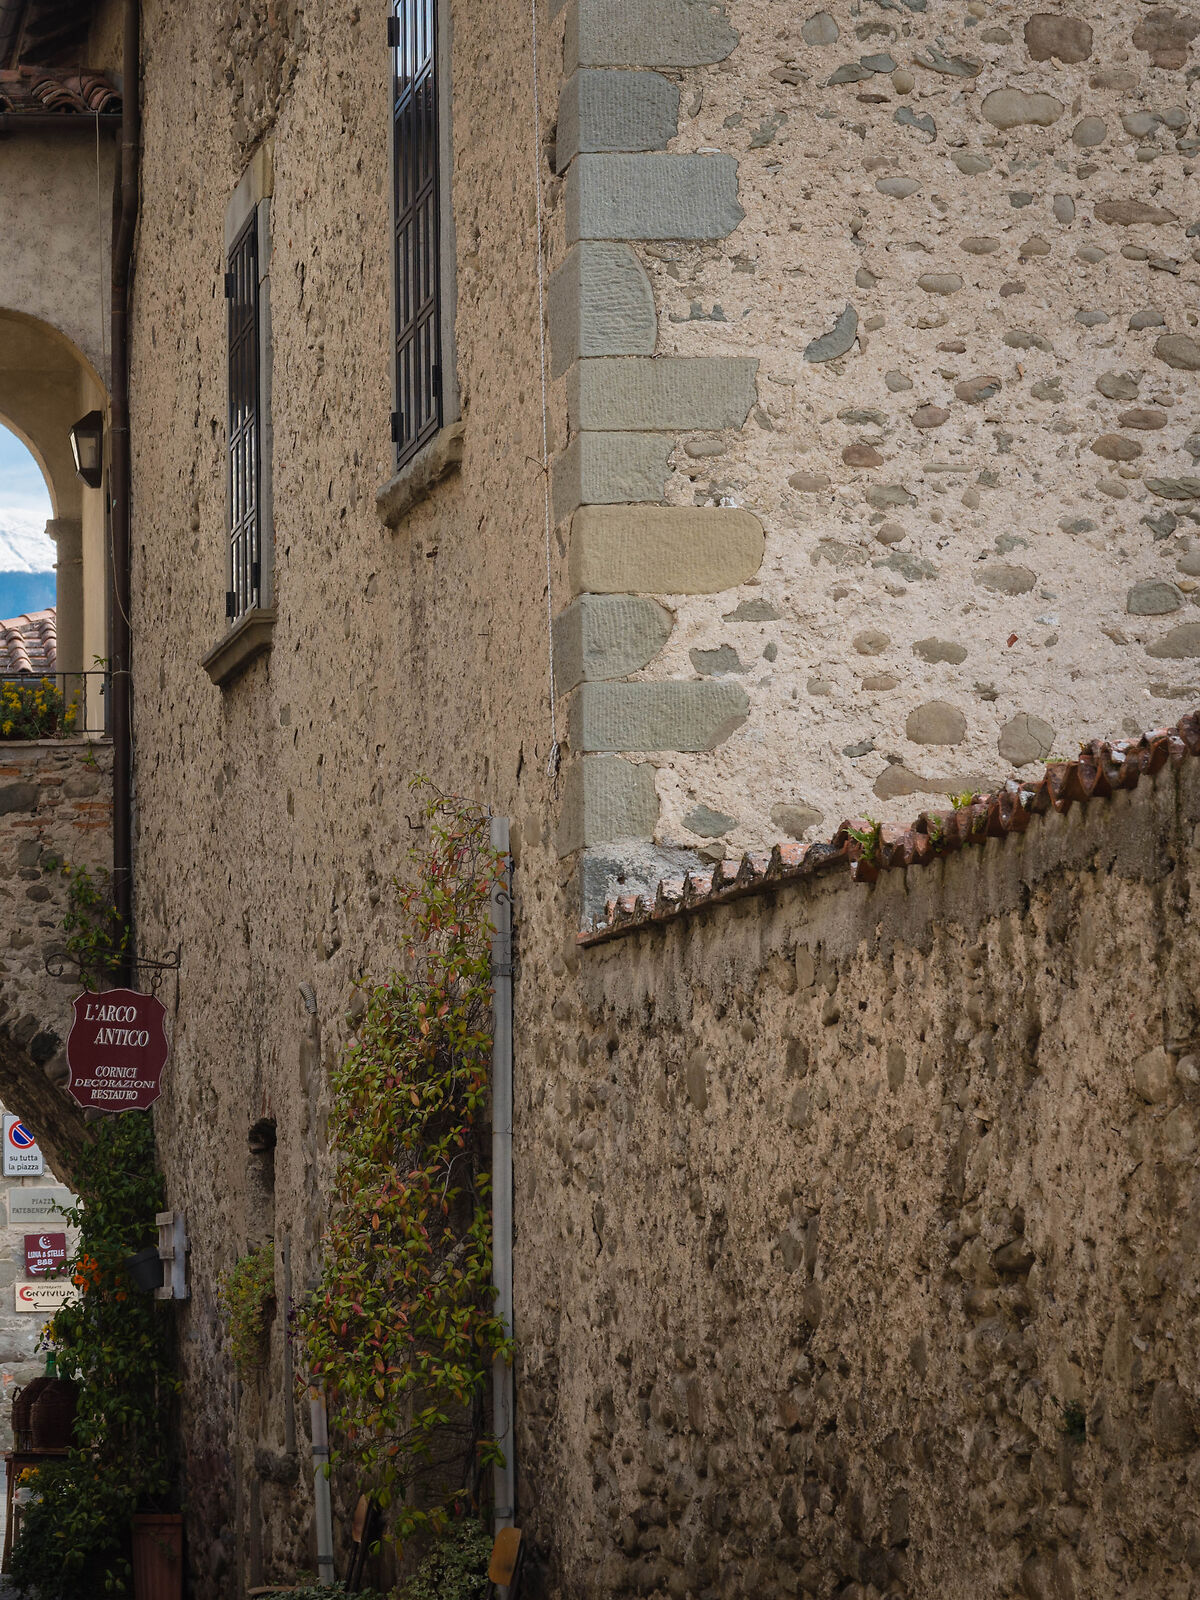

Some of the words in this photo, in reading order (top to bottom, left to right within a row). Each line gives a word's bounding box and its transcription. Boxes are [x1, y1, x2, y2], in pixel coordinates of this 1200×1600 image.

[84, 1004, 137, 1023] L'ARCO
[94, 1027, 149, 1047] ANTICO
[95, 1066, 137, 1078] CORNICI
[74, 1078, 156, 1088] DECORAZIONI
[91, 1090, 138, 1100] RESTAURO
[16, 1163, 39, 1171] piazza
[27, 1250, 41, 1259] LUNA
[47, 1249, 65, 1258] STELLE
